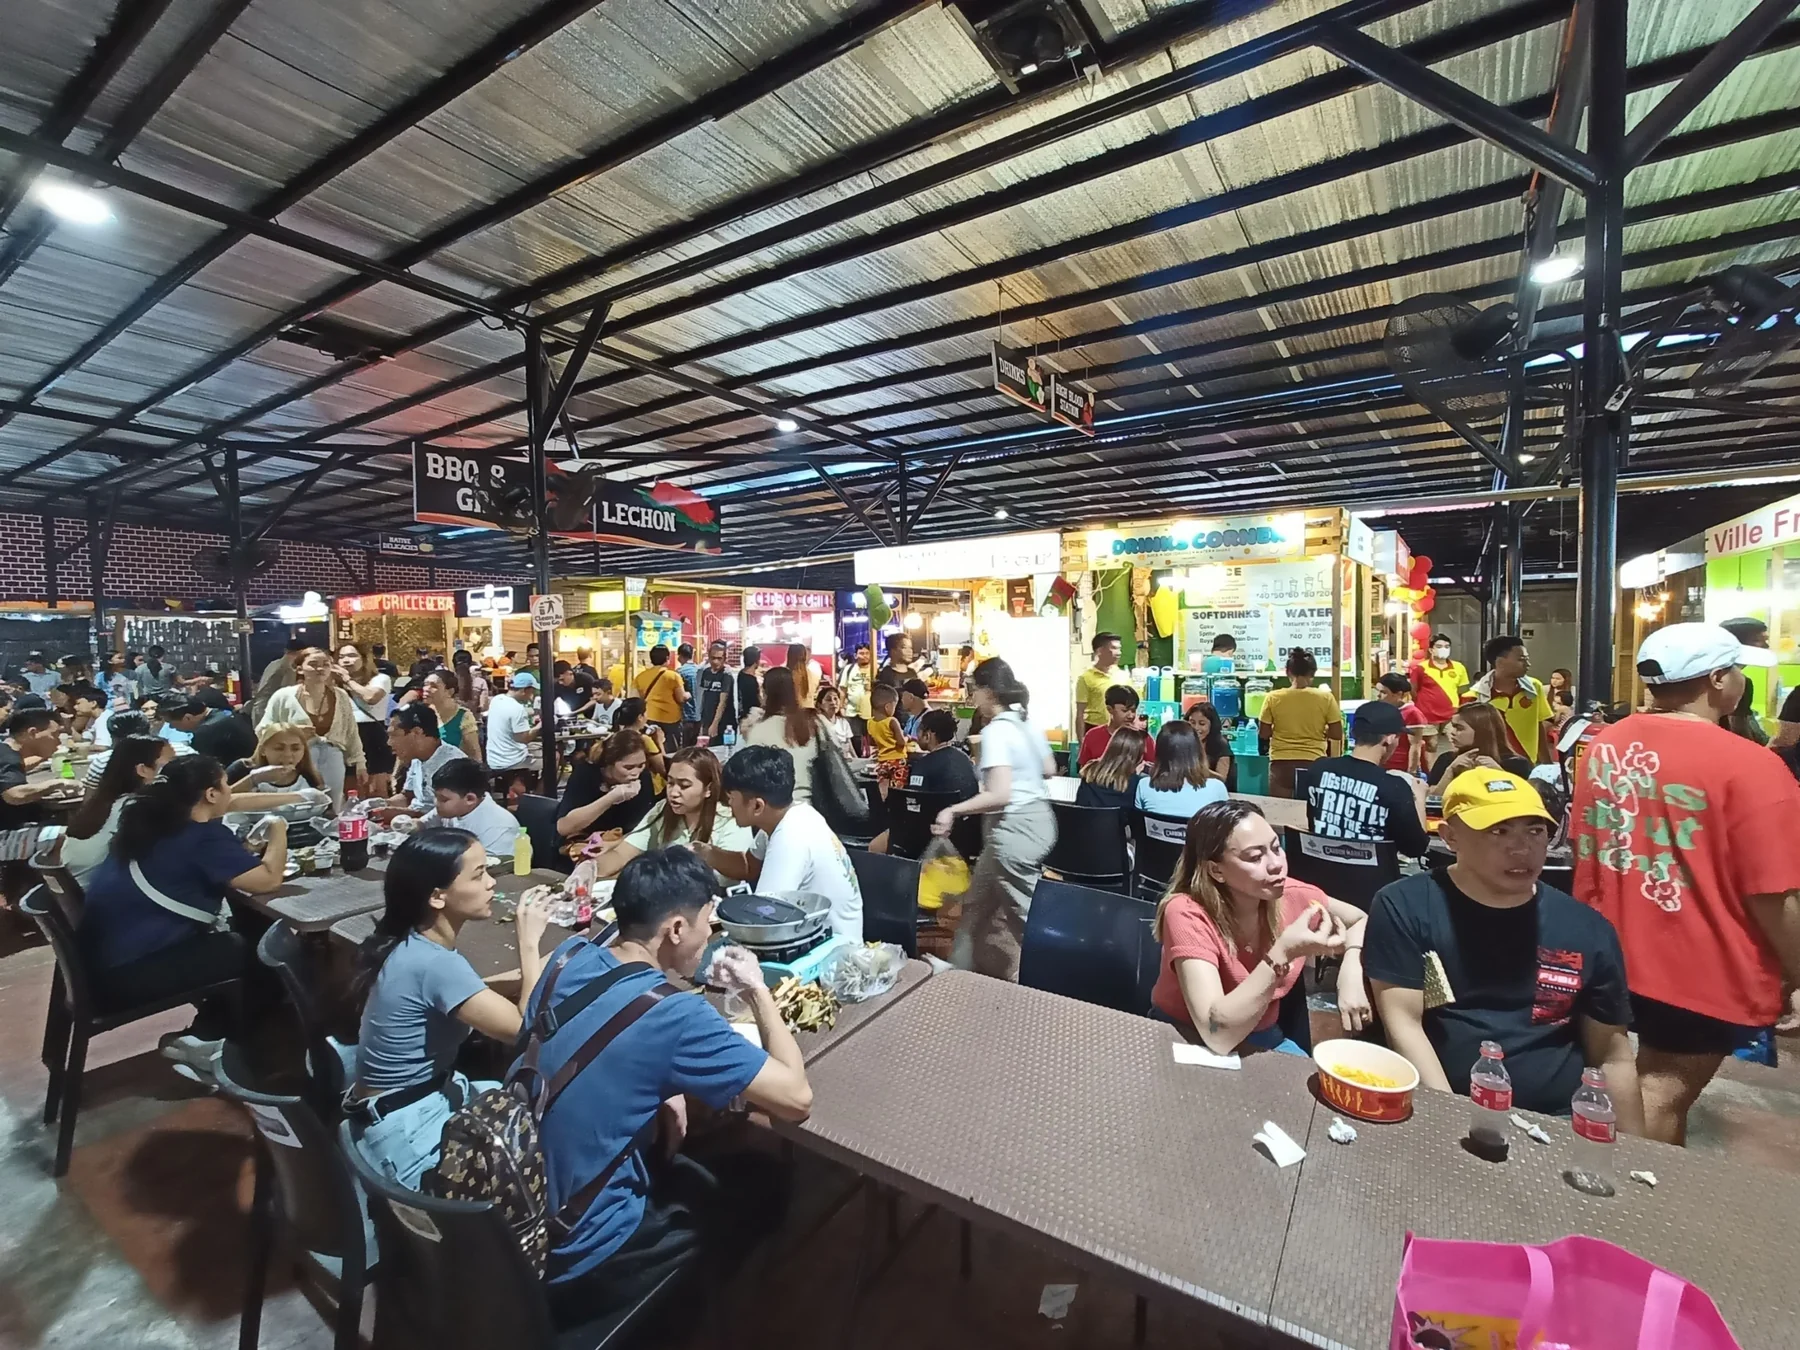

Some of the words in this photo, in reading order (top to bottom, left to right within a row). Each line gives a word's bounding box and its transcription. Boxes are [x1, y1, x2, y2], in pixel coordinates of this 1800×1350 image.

[998, 356, 1026, 386] DRINKS
[601, 500, 677, 532] LECHON
[1713, 522, 1764, 553] Ville
[1192, 609, 1261, 620] SOFTDRINKS
[1285, 607, 1333, 618] WATER
[1308, 785, 1390, 827] STRICTLY
[1321, 810, 1341, 826] FOR
[1344, 817, 1362, 834] THE
[1539, 972, 1578, 986] FUBU
